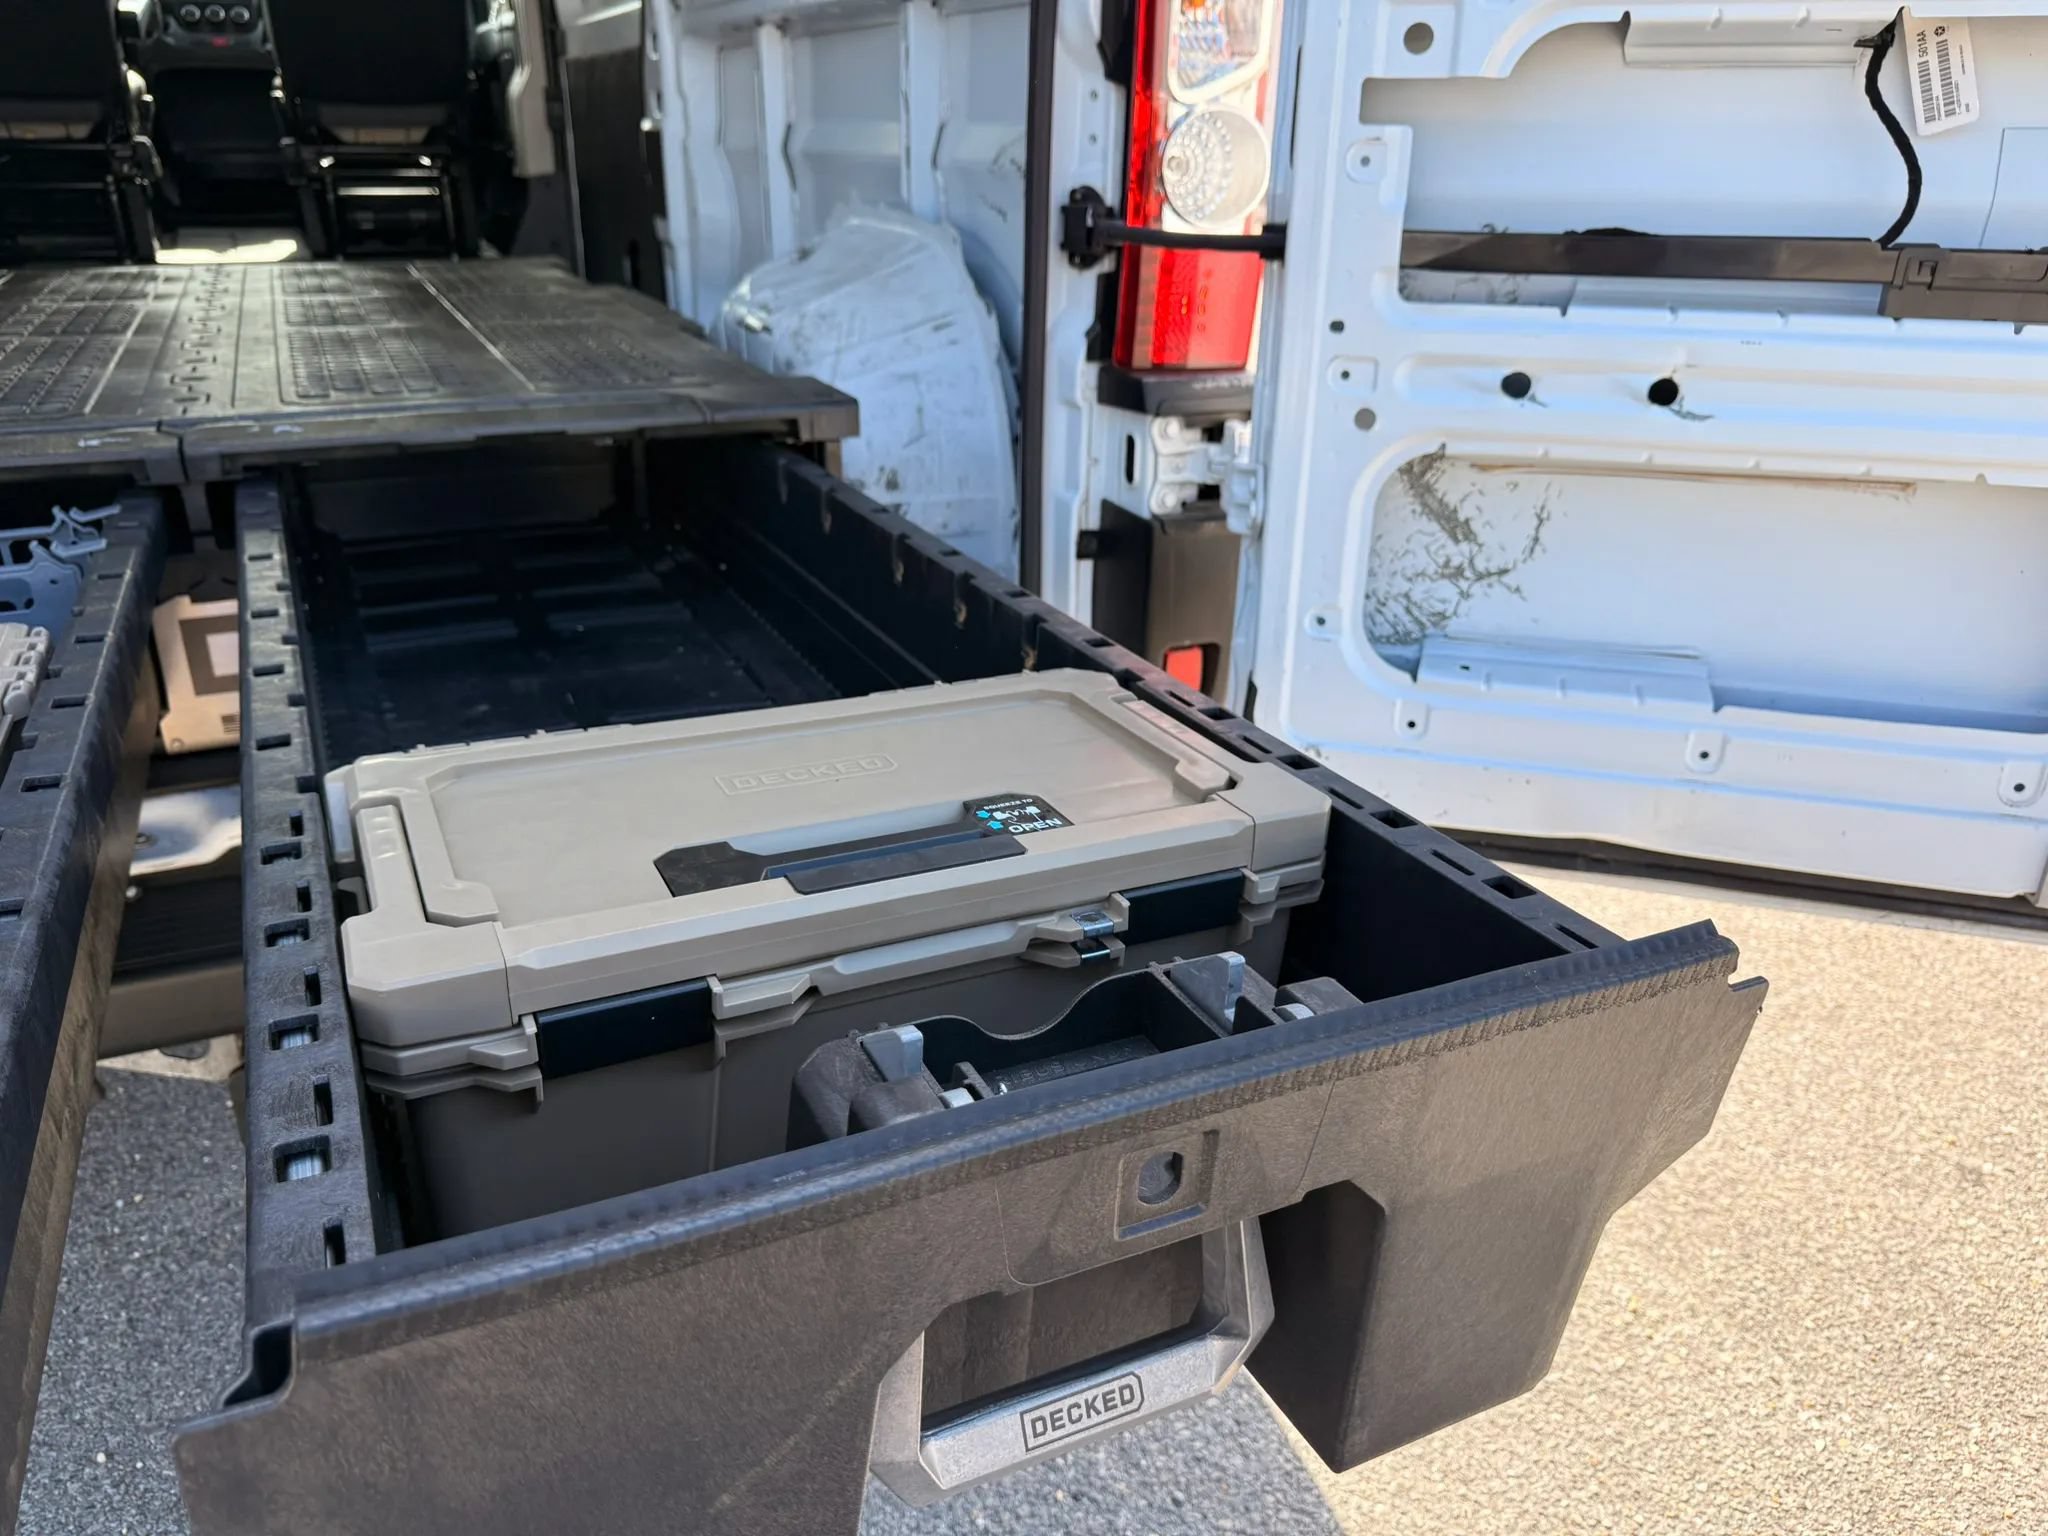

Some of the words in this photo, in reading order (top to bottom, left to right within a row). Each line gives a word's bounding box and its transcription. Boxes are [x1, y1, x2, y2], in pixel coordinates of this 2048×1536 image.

[1916, 29, 1928, 58] 501AA
[730, 757, 883, 789] DECKED
[983, 800, 1022, 810] SQUEEZE
[1008, 817, 1063, 833] OPEN
[1030, 1383, 1136, 1439] DECKED
